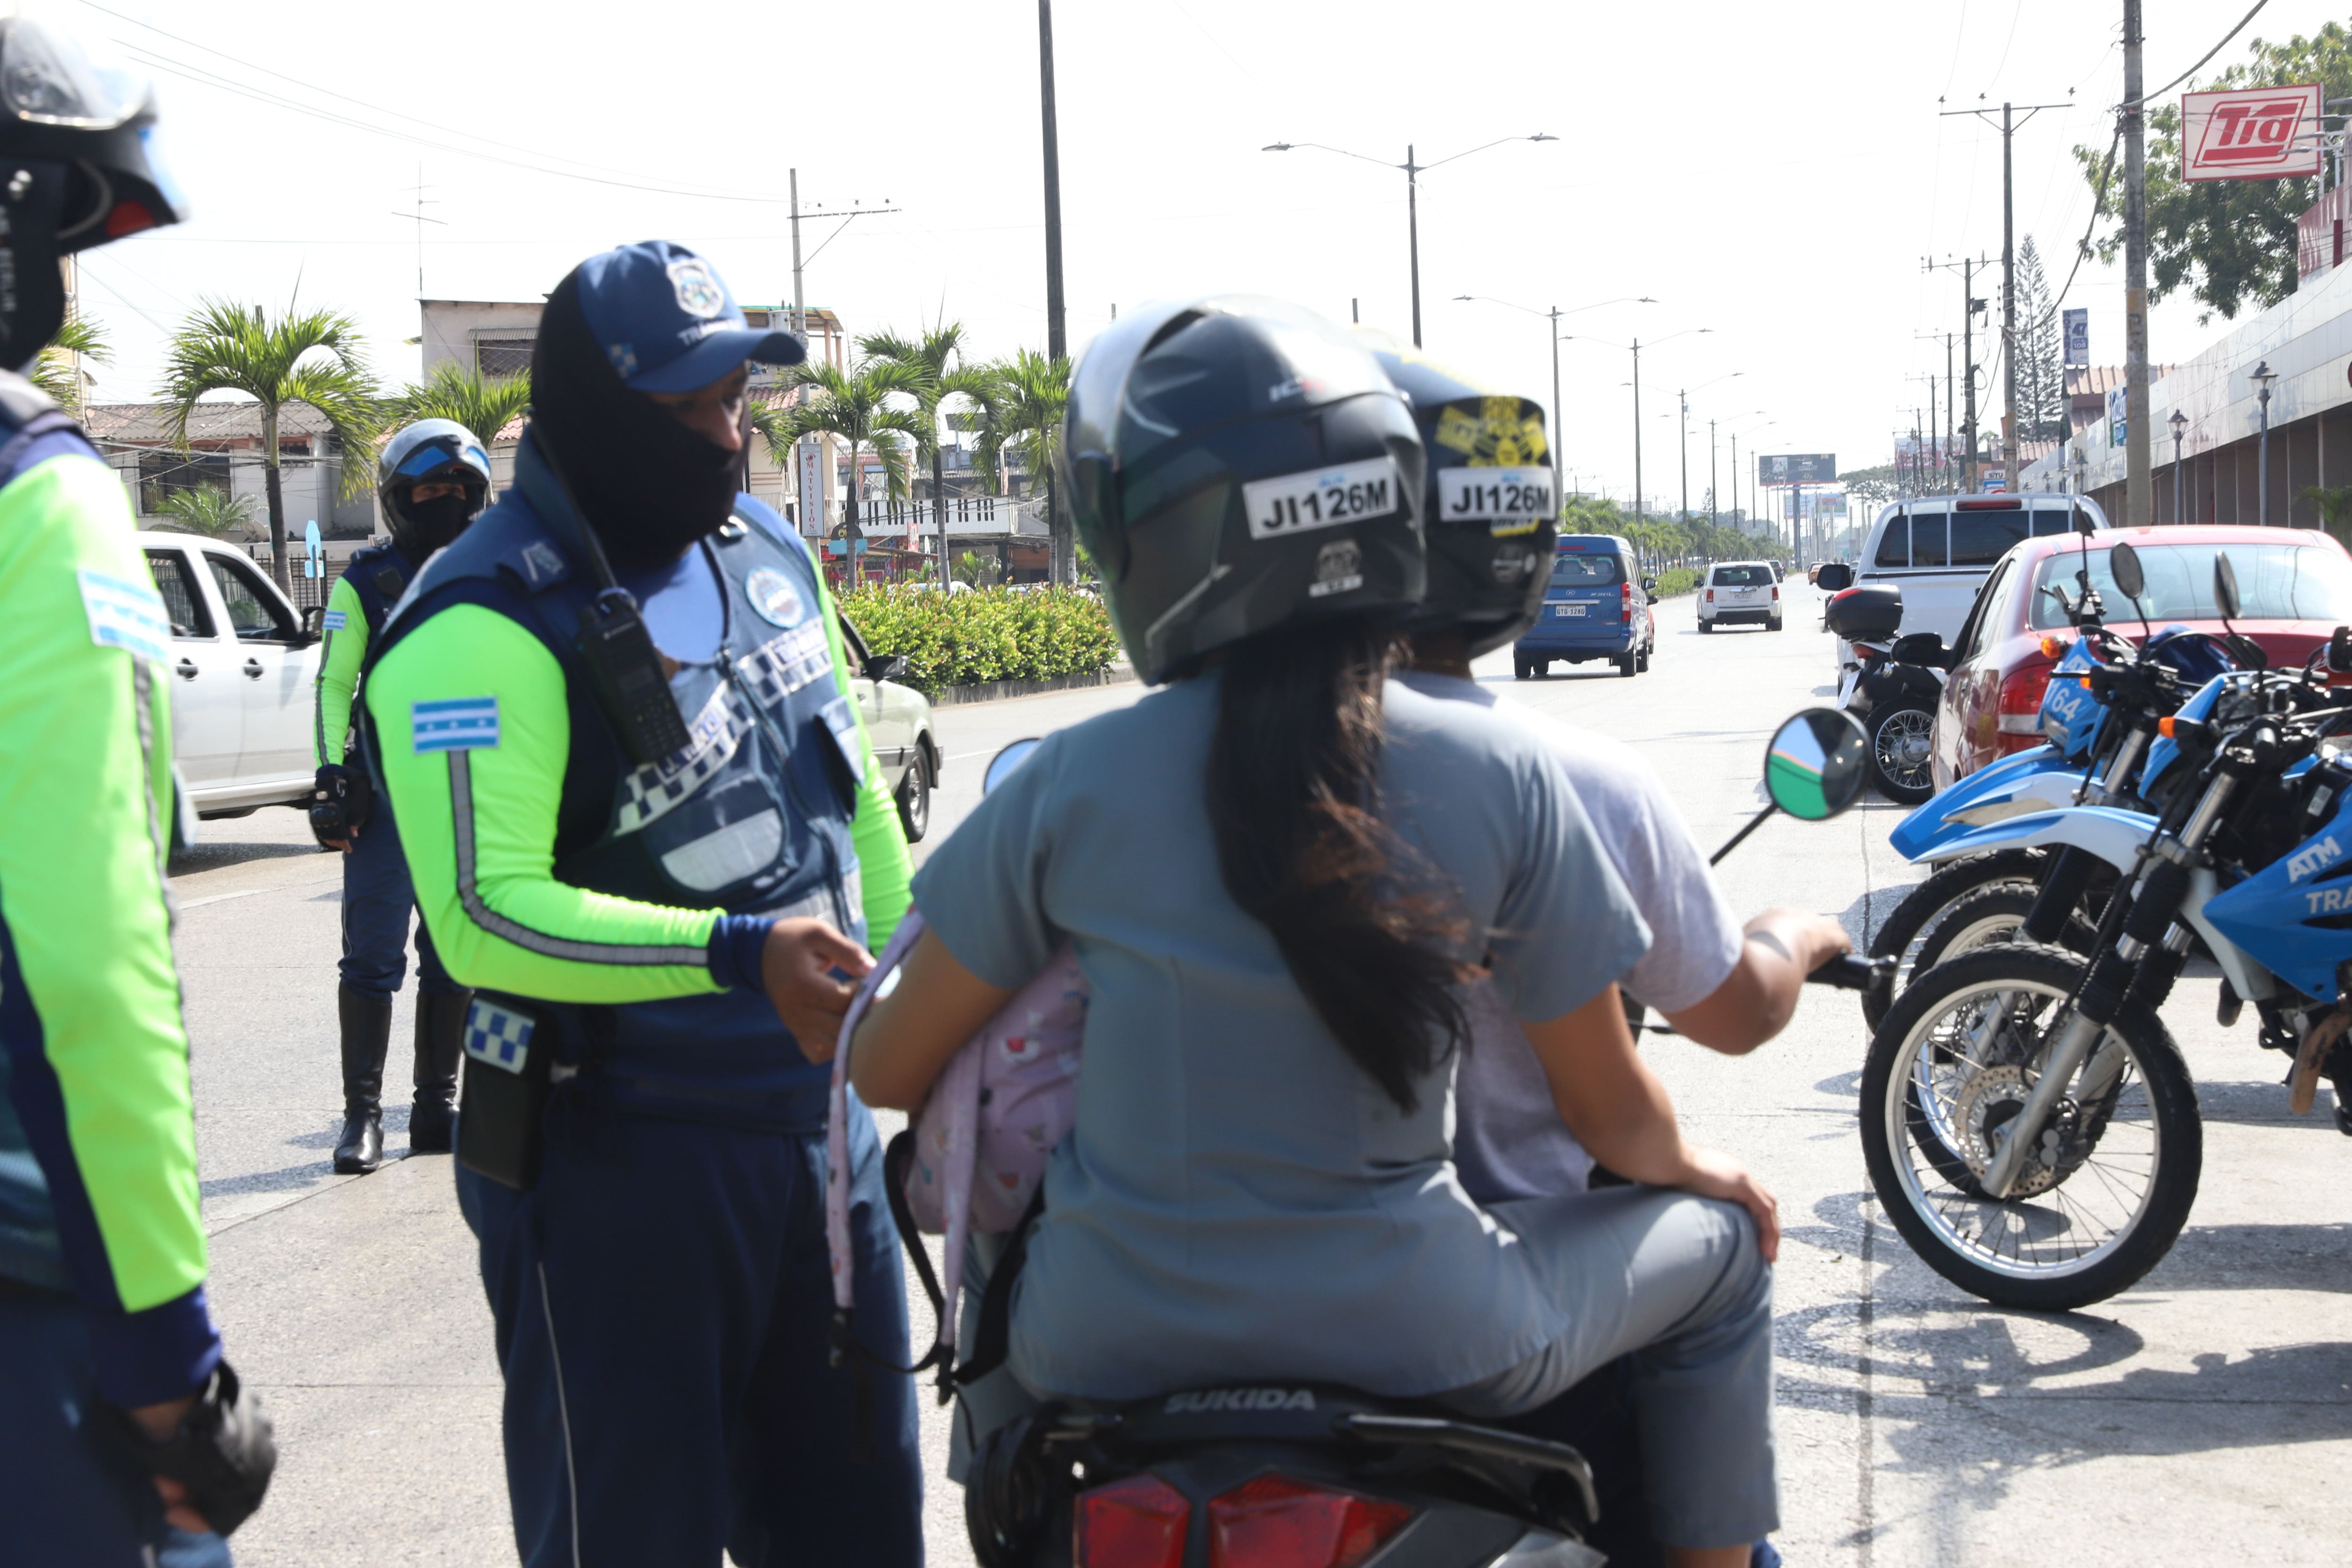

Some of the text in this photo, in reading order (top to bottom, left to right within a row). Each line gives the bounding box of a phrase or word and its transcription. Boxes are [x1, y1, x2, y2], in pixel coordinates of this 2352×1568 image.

[2072, 323, 2088, 336] 47
[806, 462, 815, 530] MATVISIÓN
[1263, 479, 1387, 530] JI126M
[1452, 485, 1549, 514] JI126M
[2047, 681, 2082, 721] 164
[2286, 836, 2342, 884] ATM
[1163, 1388, 1316, 1413] SUKIDA
